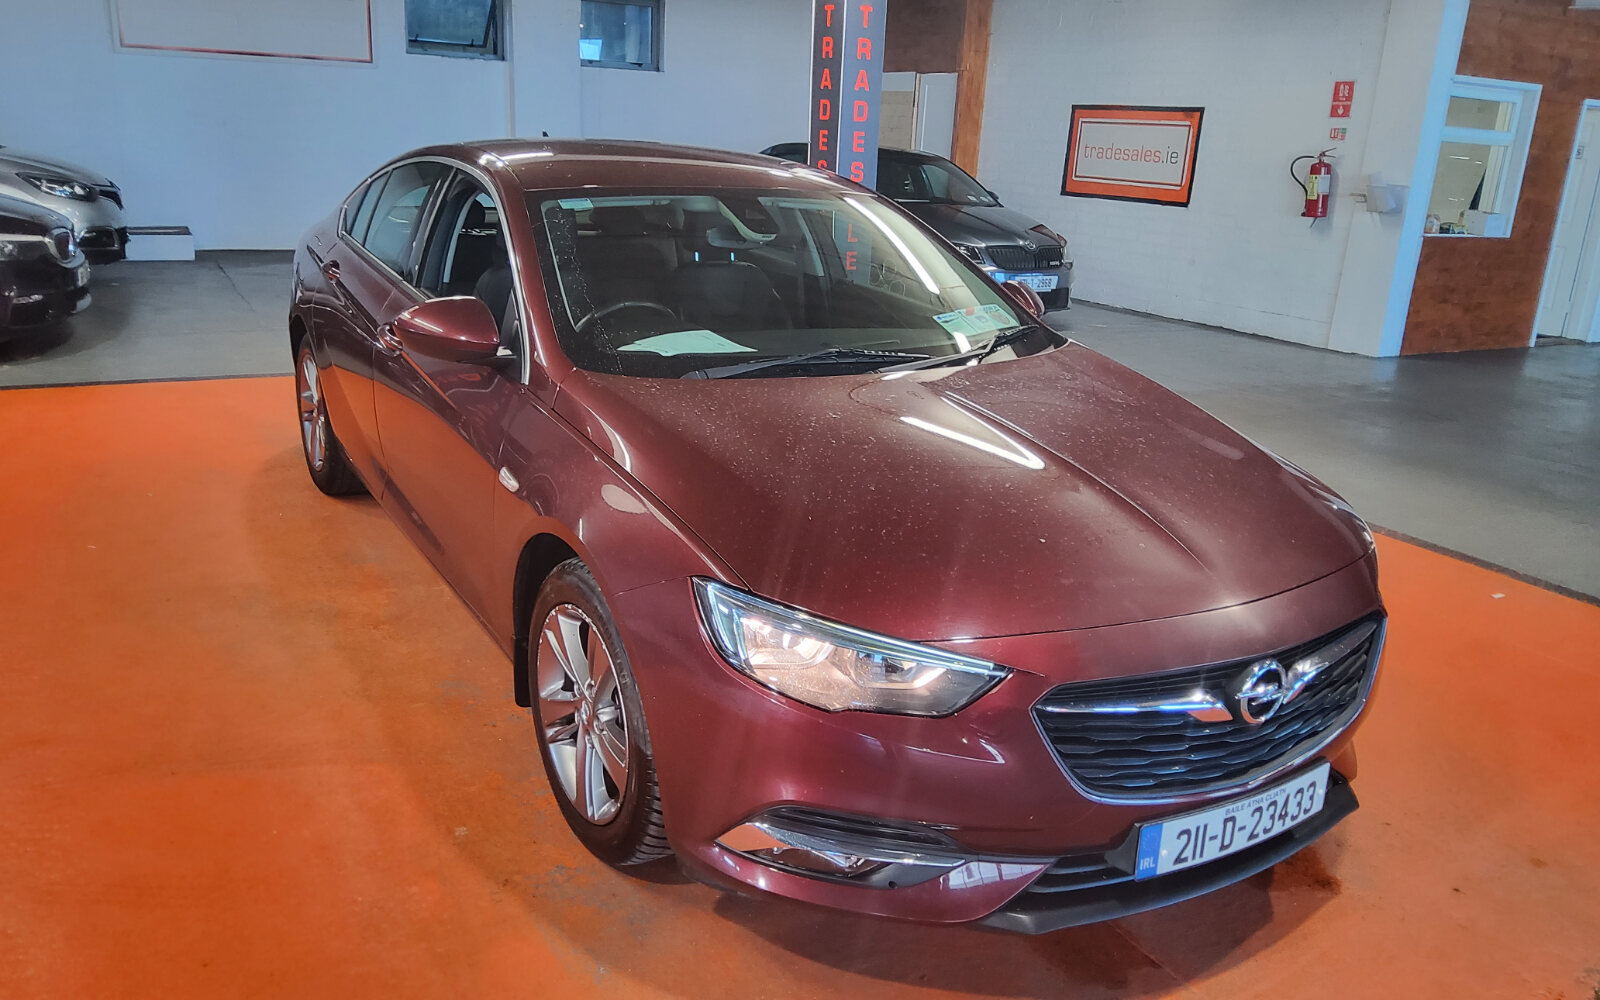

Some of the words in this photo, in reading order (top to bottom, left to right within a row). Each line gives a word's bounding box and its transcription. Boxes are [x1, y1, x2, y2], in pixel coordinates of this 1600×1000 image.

[850, 5, 873, 183] TRADES
[1084, 143, 1179, 165] tradesales.ie
[1173, 780, 1317, 866] 211-D-23433
[1140, 858, 1156, 871] IRL
